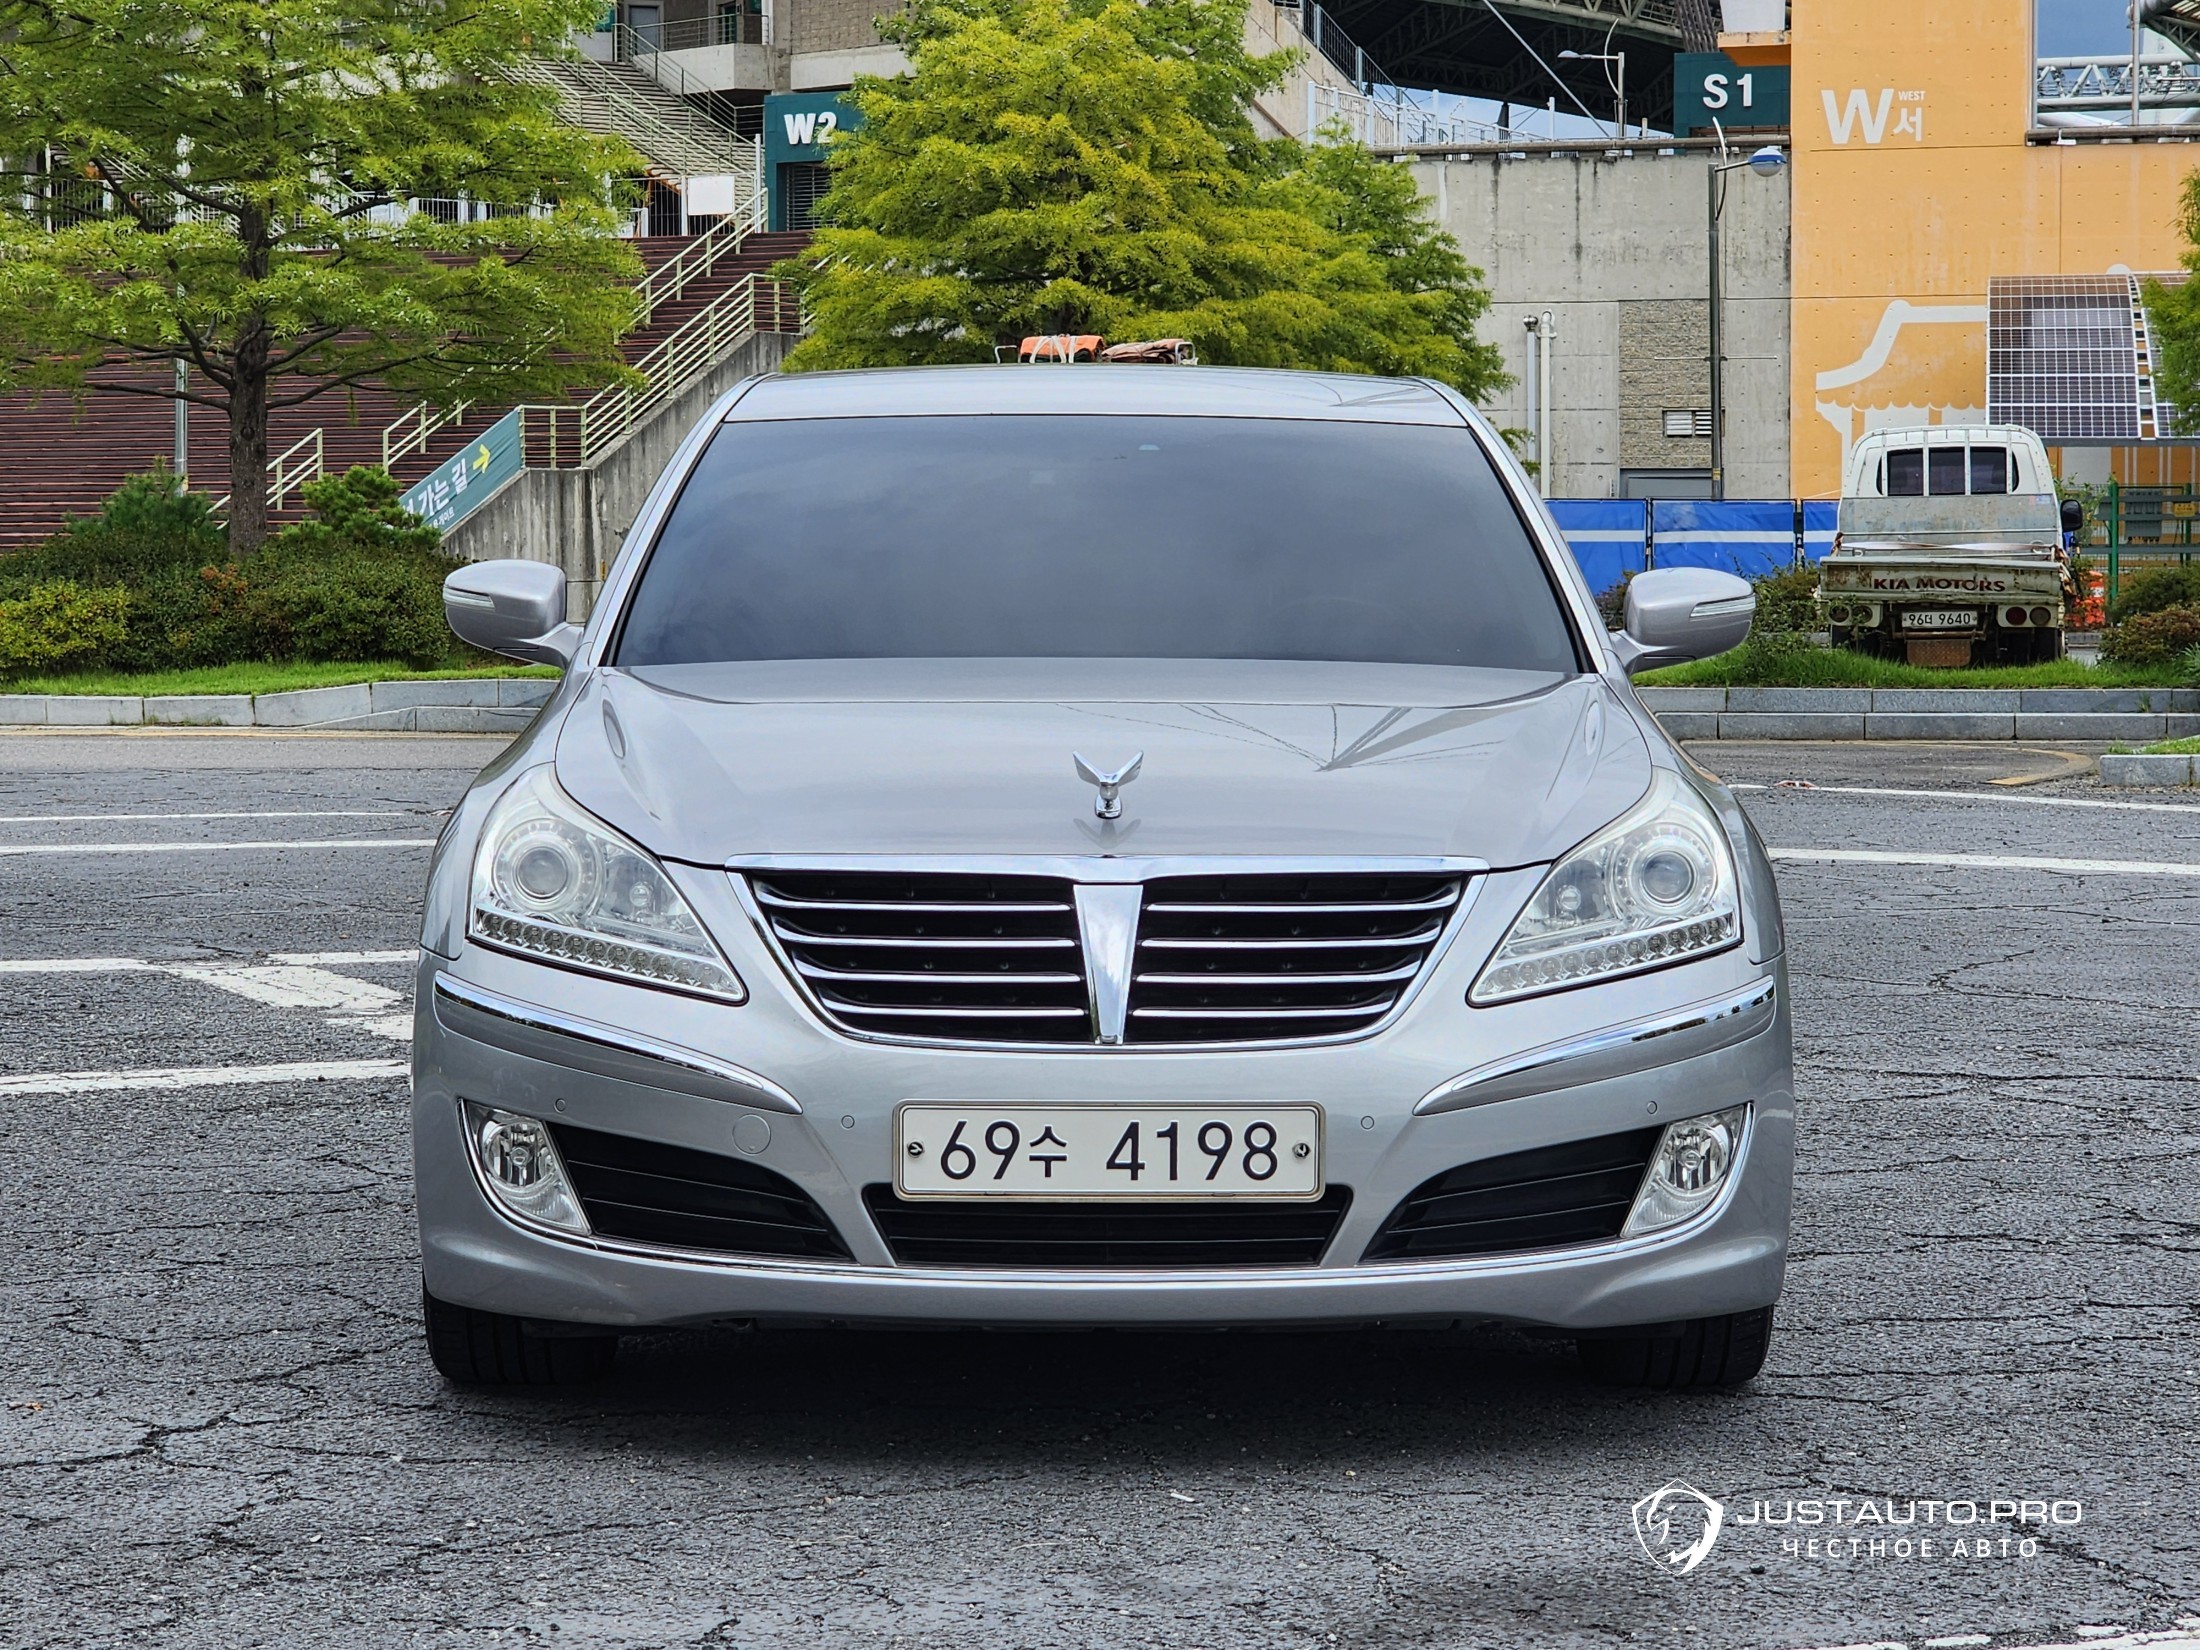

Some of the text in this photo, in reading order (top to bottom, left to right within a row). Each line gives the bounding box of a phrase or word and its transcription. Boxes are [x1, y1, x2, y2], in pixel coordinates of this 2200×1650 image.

[1898, 90, 1926, 101] WEST
[784, 111, 837, 145] W2
[1821, 88, 1894, 145] W
[1892, 107, 1922, 142] 서
[418, 479, 450, 516] 가는
[452, 458, 468, 495] 길
[1873, 578, 2006, 592] KIA MOTORS
[1938, 612, 1971, 625] 9640
[940, 1120, 1278, 1181] 69수 4198
